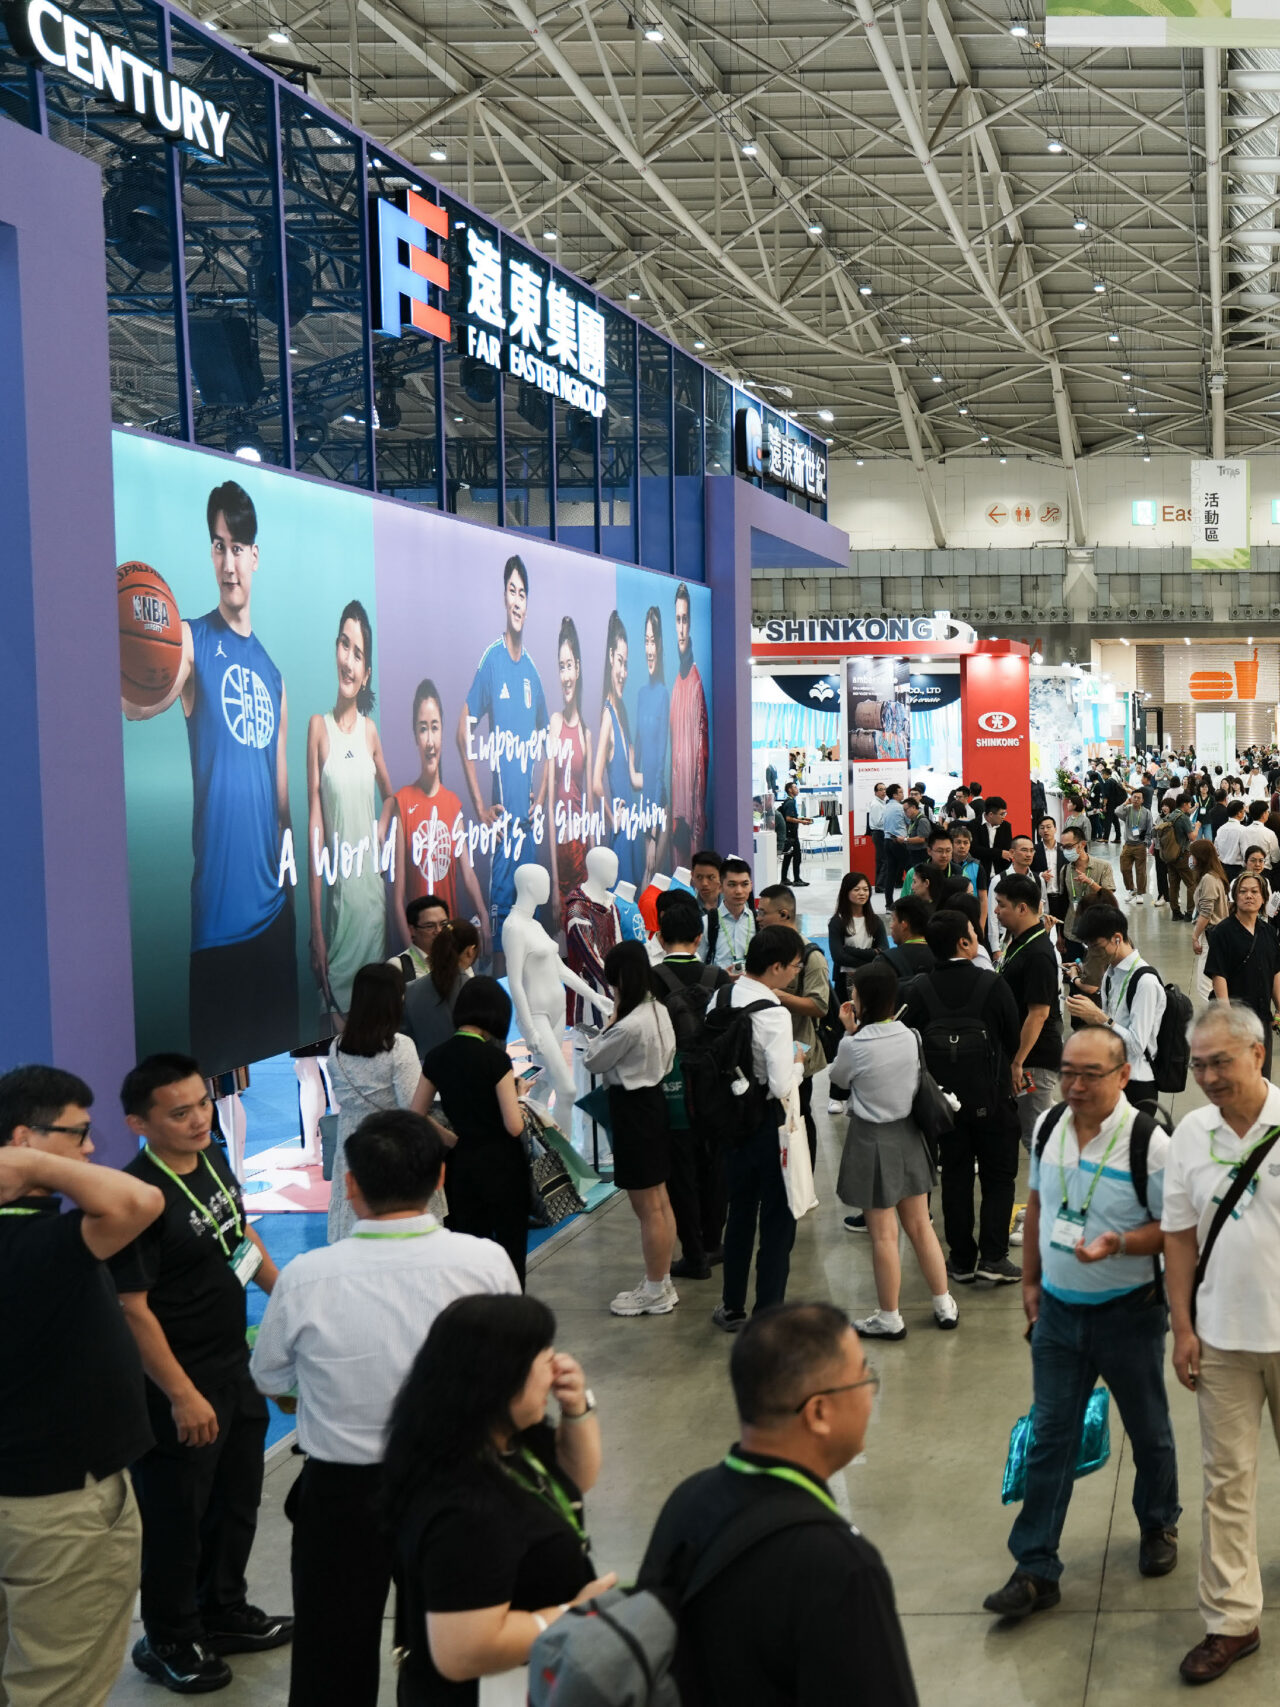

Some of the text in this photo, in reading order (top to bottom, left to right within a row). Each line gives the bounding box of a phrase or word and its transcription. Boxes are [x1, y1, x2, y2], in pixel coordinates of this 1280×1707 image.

[28, 0, 230, 158] CENTURY
[467, 228, 605, 387] 遠東集團
[467, 325, 501, 369] FAR
[768, 423, 827, 500] 遠東新世紀
[1204, 492, 1220, 542] 活動區
[141, 596, 170, 629] NBA
[766, 618, 933, 642] SHINKONG
[926, 687, 941, 695] LTD
[466, 716, 574, 792] Empowering
[976, 737, 1020, 747] SHINKONG
[278, 828, 297, 888] A
[314, 816, 398, 886] World
[412, 805, 439, 896] of
[453, 810, 527, 868] Sports
[555, 796, 606, 847] Global
[613, 797, 667, 841] Fashion
